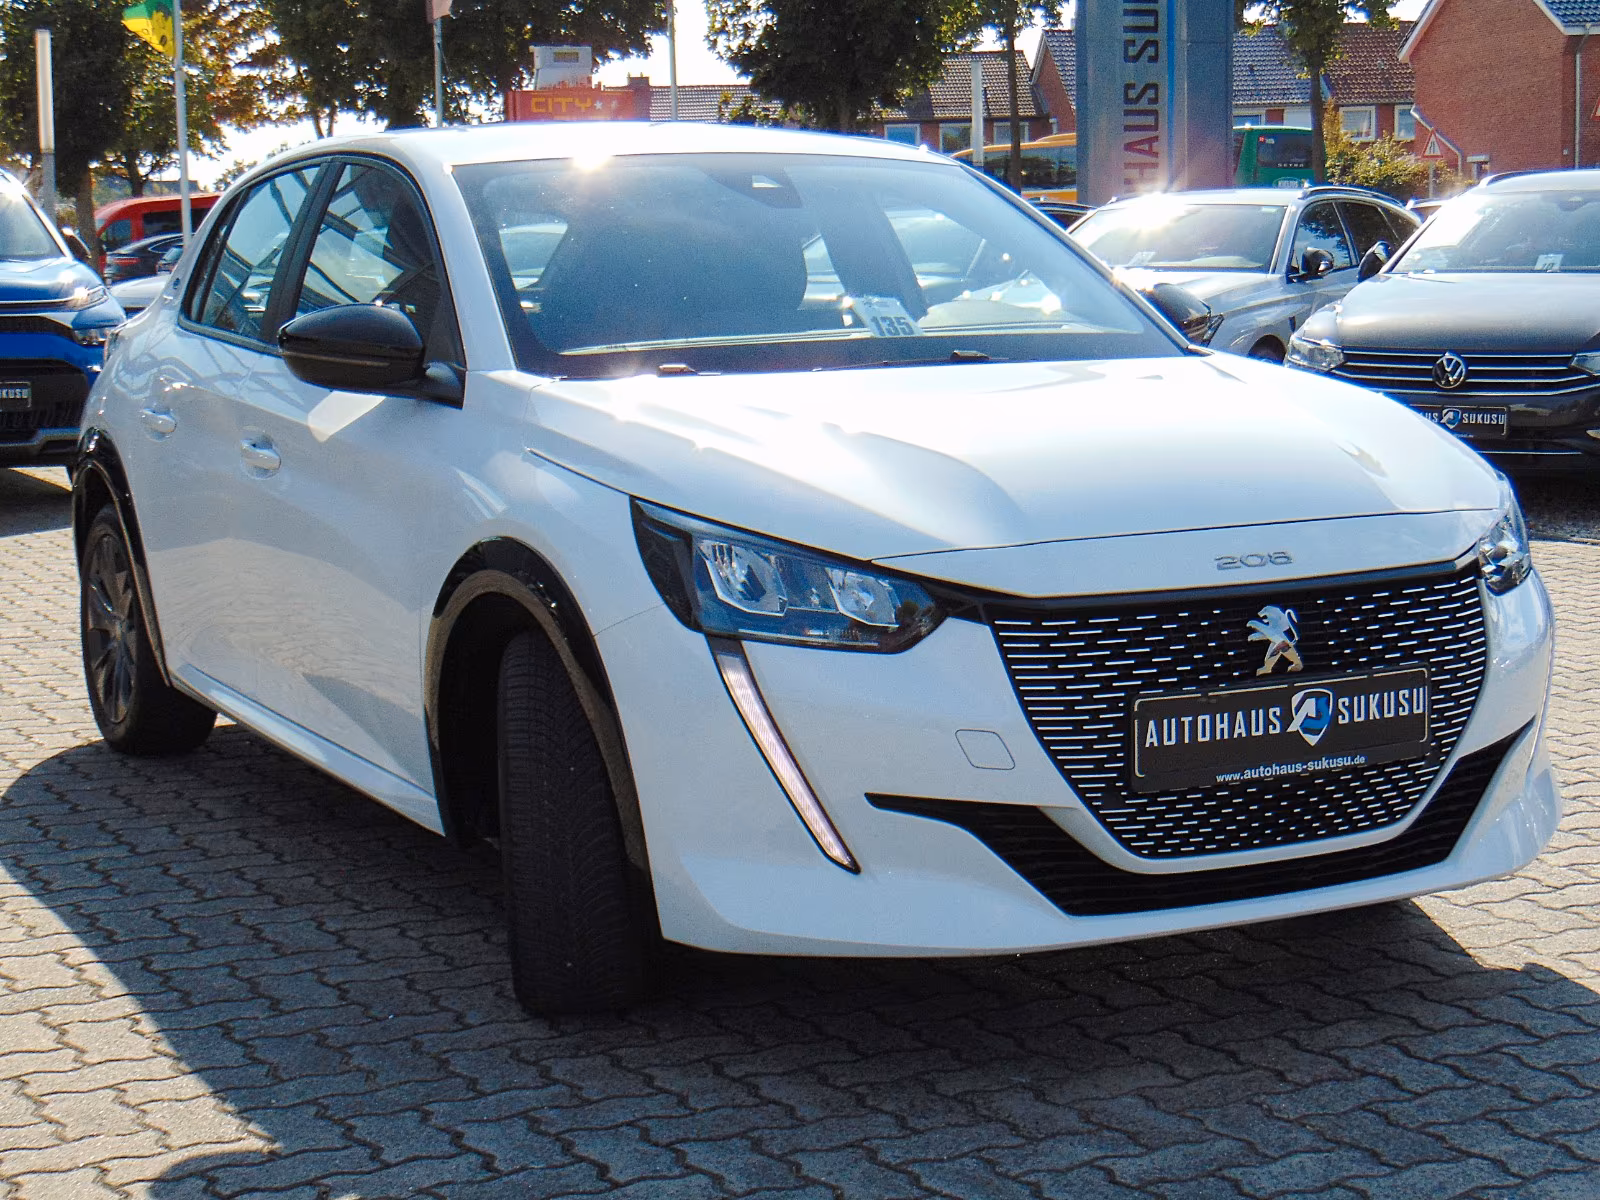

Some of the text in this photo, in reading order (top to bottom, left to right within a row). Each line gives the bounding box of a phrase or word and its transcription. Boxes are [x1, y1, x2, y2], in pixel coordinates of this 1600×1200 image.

[1123, 0, 1159, 63] SU
[531, 97, 593, 113] CITY
[870, 316, 915, 337] 135
[0, 388, 29, 399] KUSU
[1462, 413, 1505, 425] SUKUSU
[1215, 551, 1293, 571] 208
[1145, 686, 1426, 748] AUTOHAUS SUKUSU
[1216, 754, 1366, 783] www.autohaus-sukusu.de
